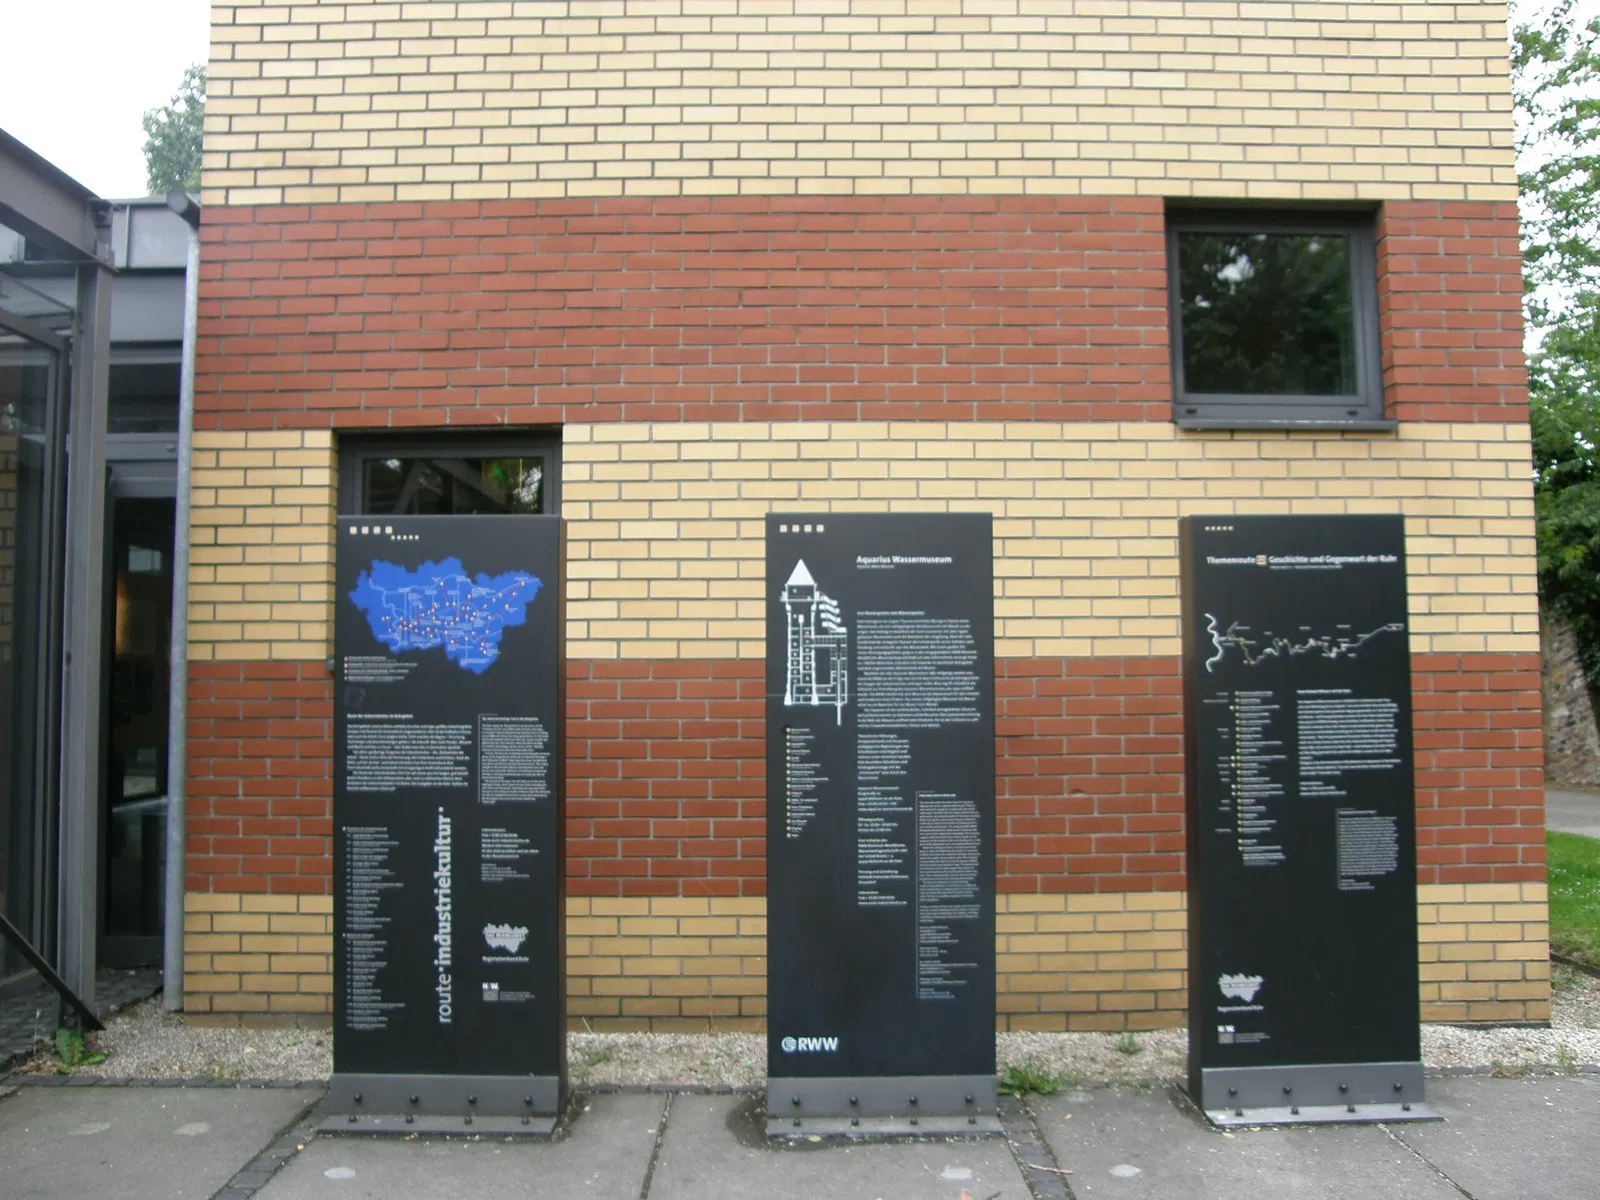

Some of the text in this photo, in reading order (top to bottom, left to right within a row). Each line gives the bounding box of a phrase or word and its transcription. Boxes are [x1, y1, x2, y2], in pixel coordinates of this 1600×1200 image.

[856, 555, 953, 565] Aquarius Wassermuseum
[1206, 556, 1255, 564] Themenroute
[1268, 555, 1308, 563] Geschichte
[797, 1036, 839, 1051] RWW
